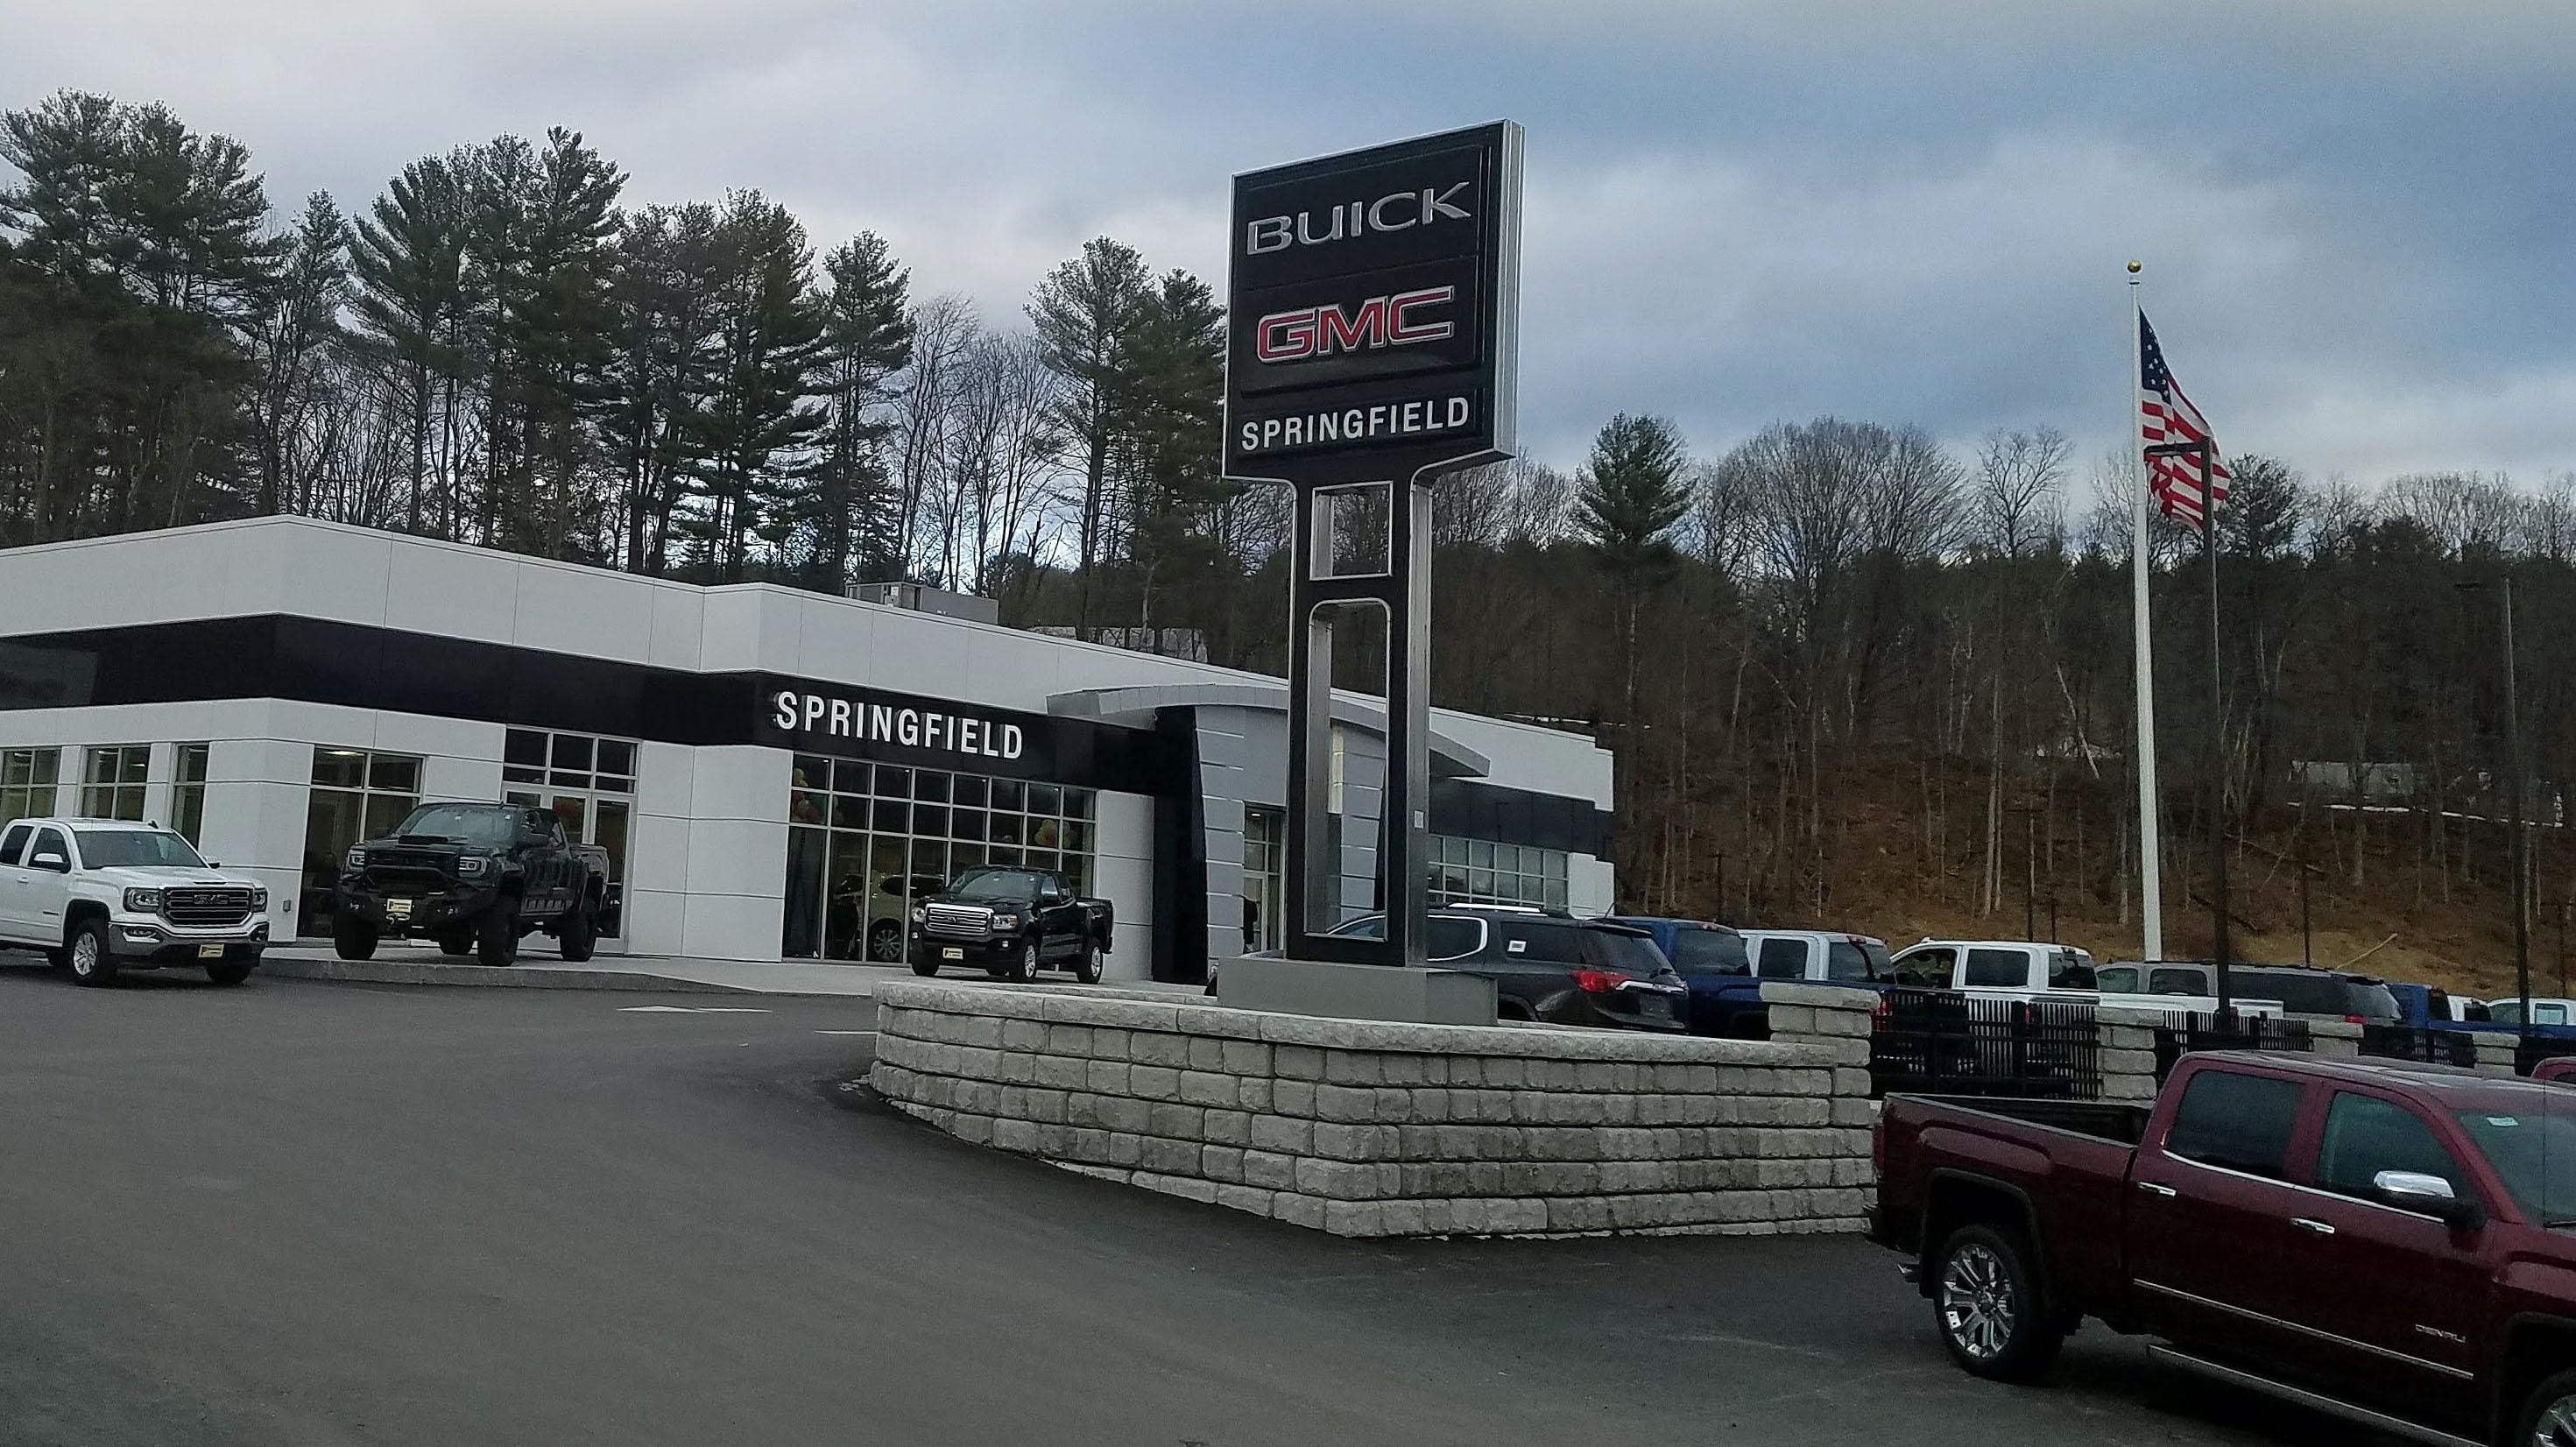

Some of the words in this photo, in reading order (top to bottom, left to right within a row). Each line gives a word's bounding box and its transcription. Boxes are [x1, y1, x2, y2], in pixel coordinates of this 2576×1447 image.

[1246, 181, 1471, 255] BUICK
[1256, 285, 1456, 364] GMC
[1241, 397, 1469, 450] SPRINGFIELD
[774, 691, 1023, 759] SPRINGFIELD
